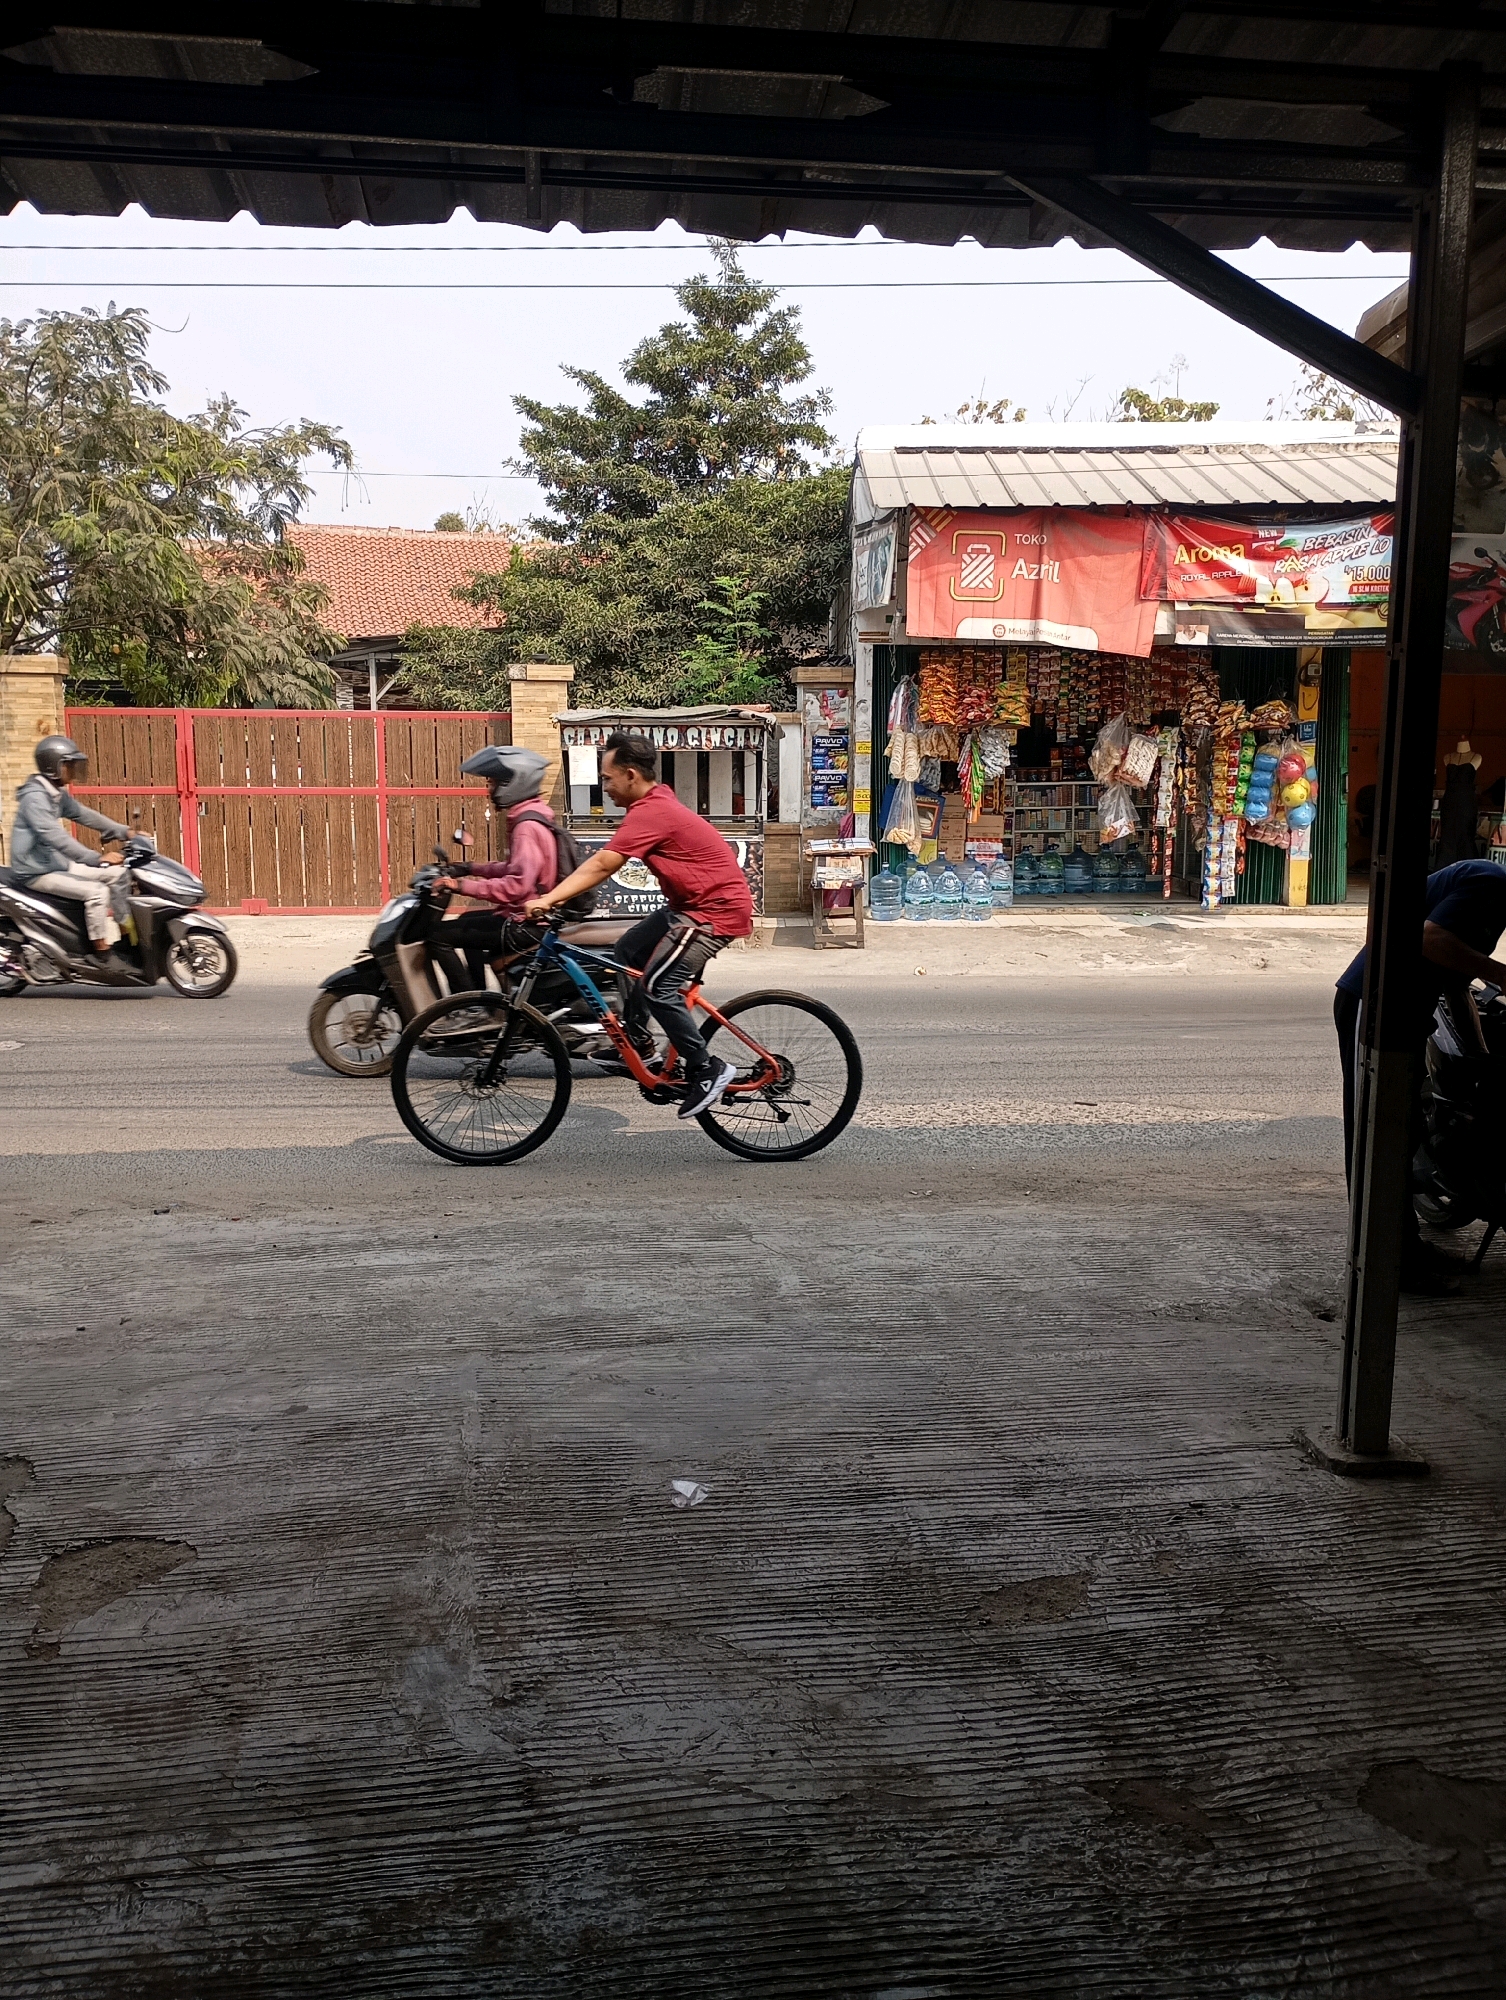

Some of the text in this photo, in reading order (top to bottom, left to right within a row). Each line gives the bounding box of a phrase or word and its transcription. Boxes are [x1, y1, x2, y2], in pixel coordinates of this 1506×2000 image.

[1014, 533, 1047, 545] TOKO
[1258, 529, 1278, 538] NEW
[1303, 525, 1371, 552] BEBASIN
[1173, 544, 1245, 565] Aroma
[1273, 537, 1391, 574] RASA APPLE LO
[1010, 557, 1060, 583] Azril
[1180, 571, 1244, 582] ROYAL APPLE
[687, 727, 762, 748] CINCAU
